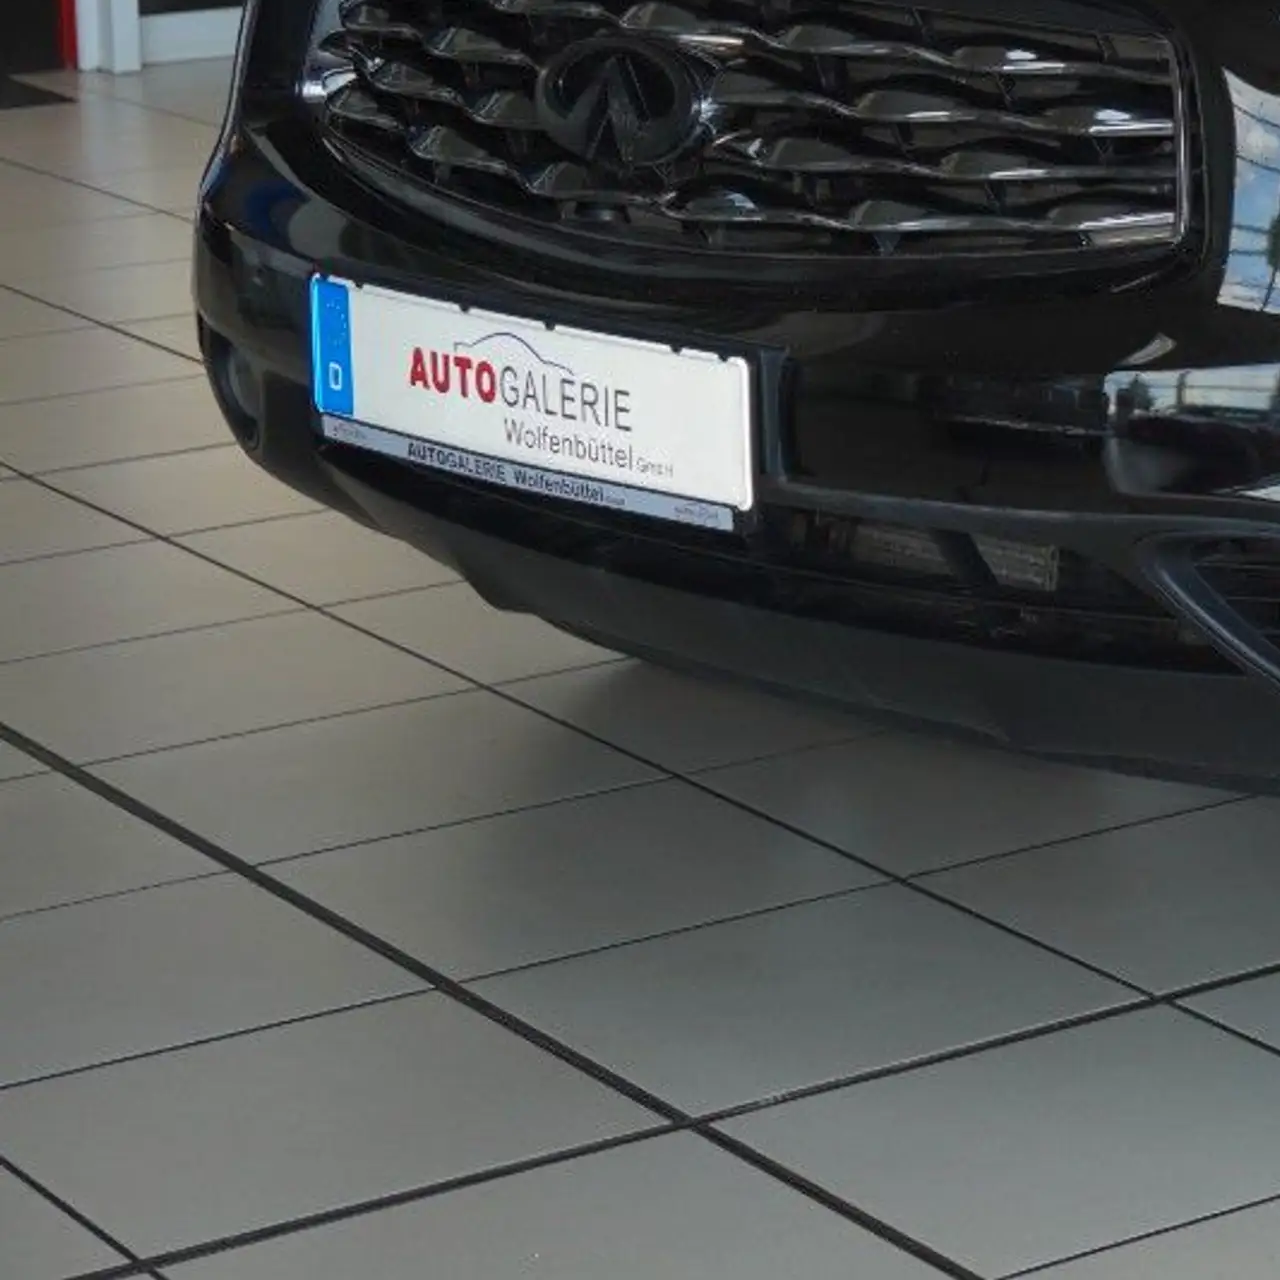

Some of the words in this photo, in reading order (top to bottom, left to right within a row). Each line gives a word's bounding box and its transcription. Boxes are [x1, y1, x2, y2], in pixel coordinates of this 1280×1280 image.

[328, 361, 343, 391] D
[409, 346, 633, 432] AUTOGALERIE
[407, 441, 506, 485] AUTOGALERIE
[503, 417, 633, 471] Wolfenbüttel
